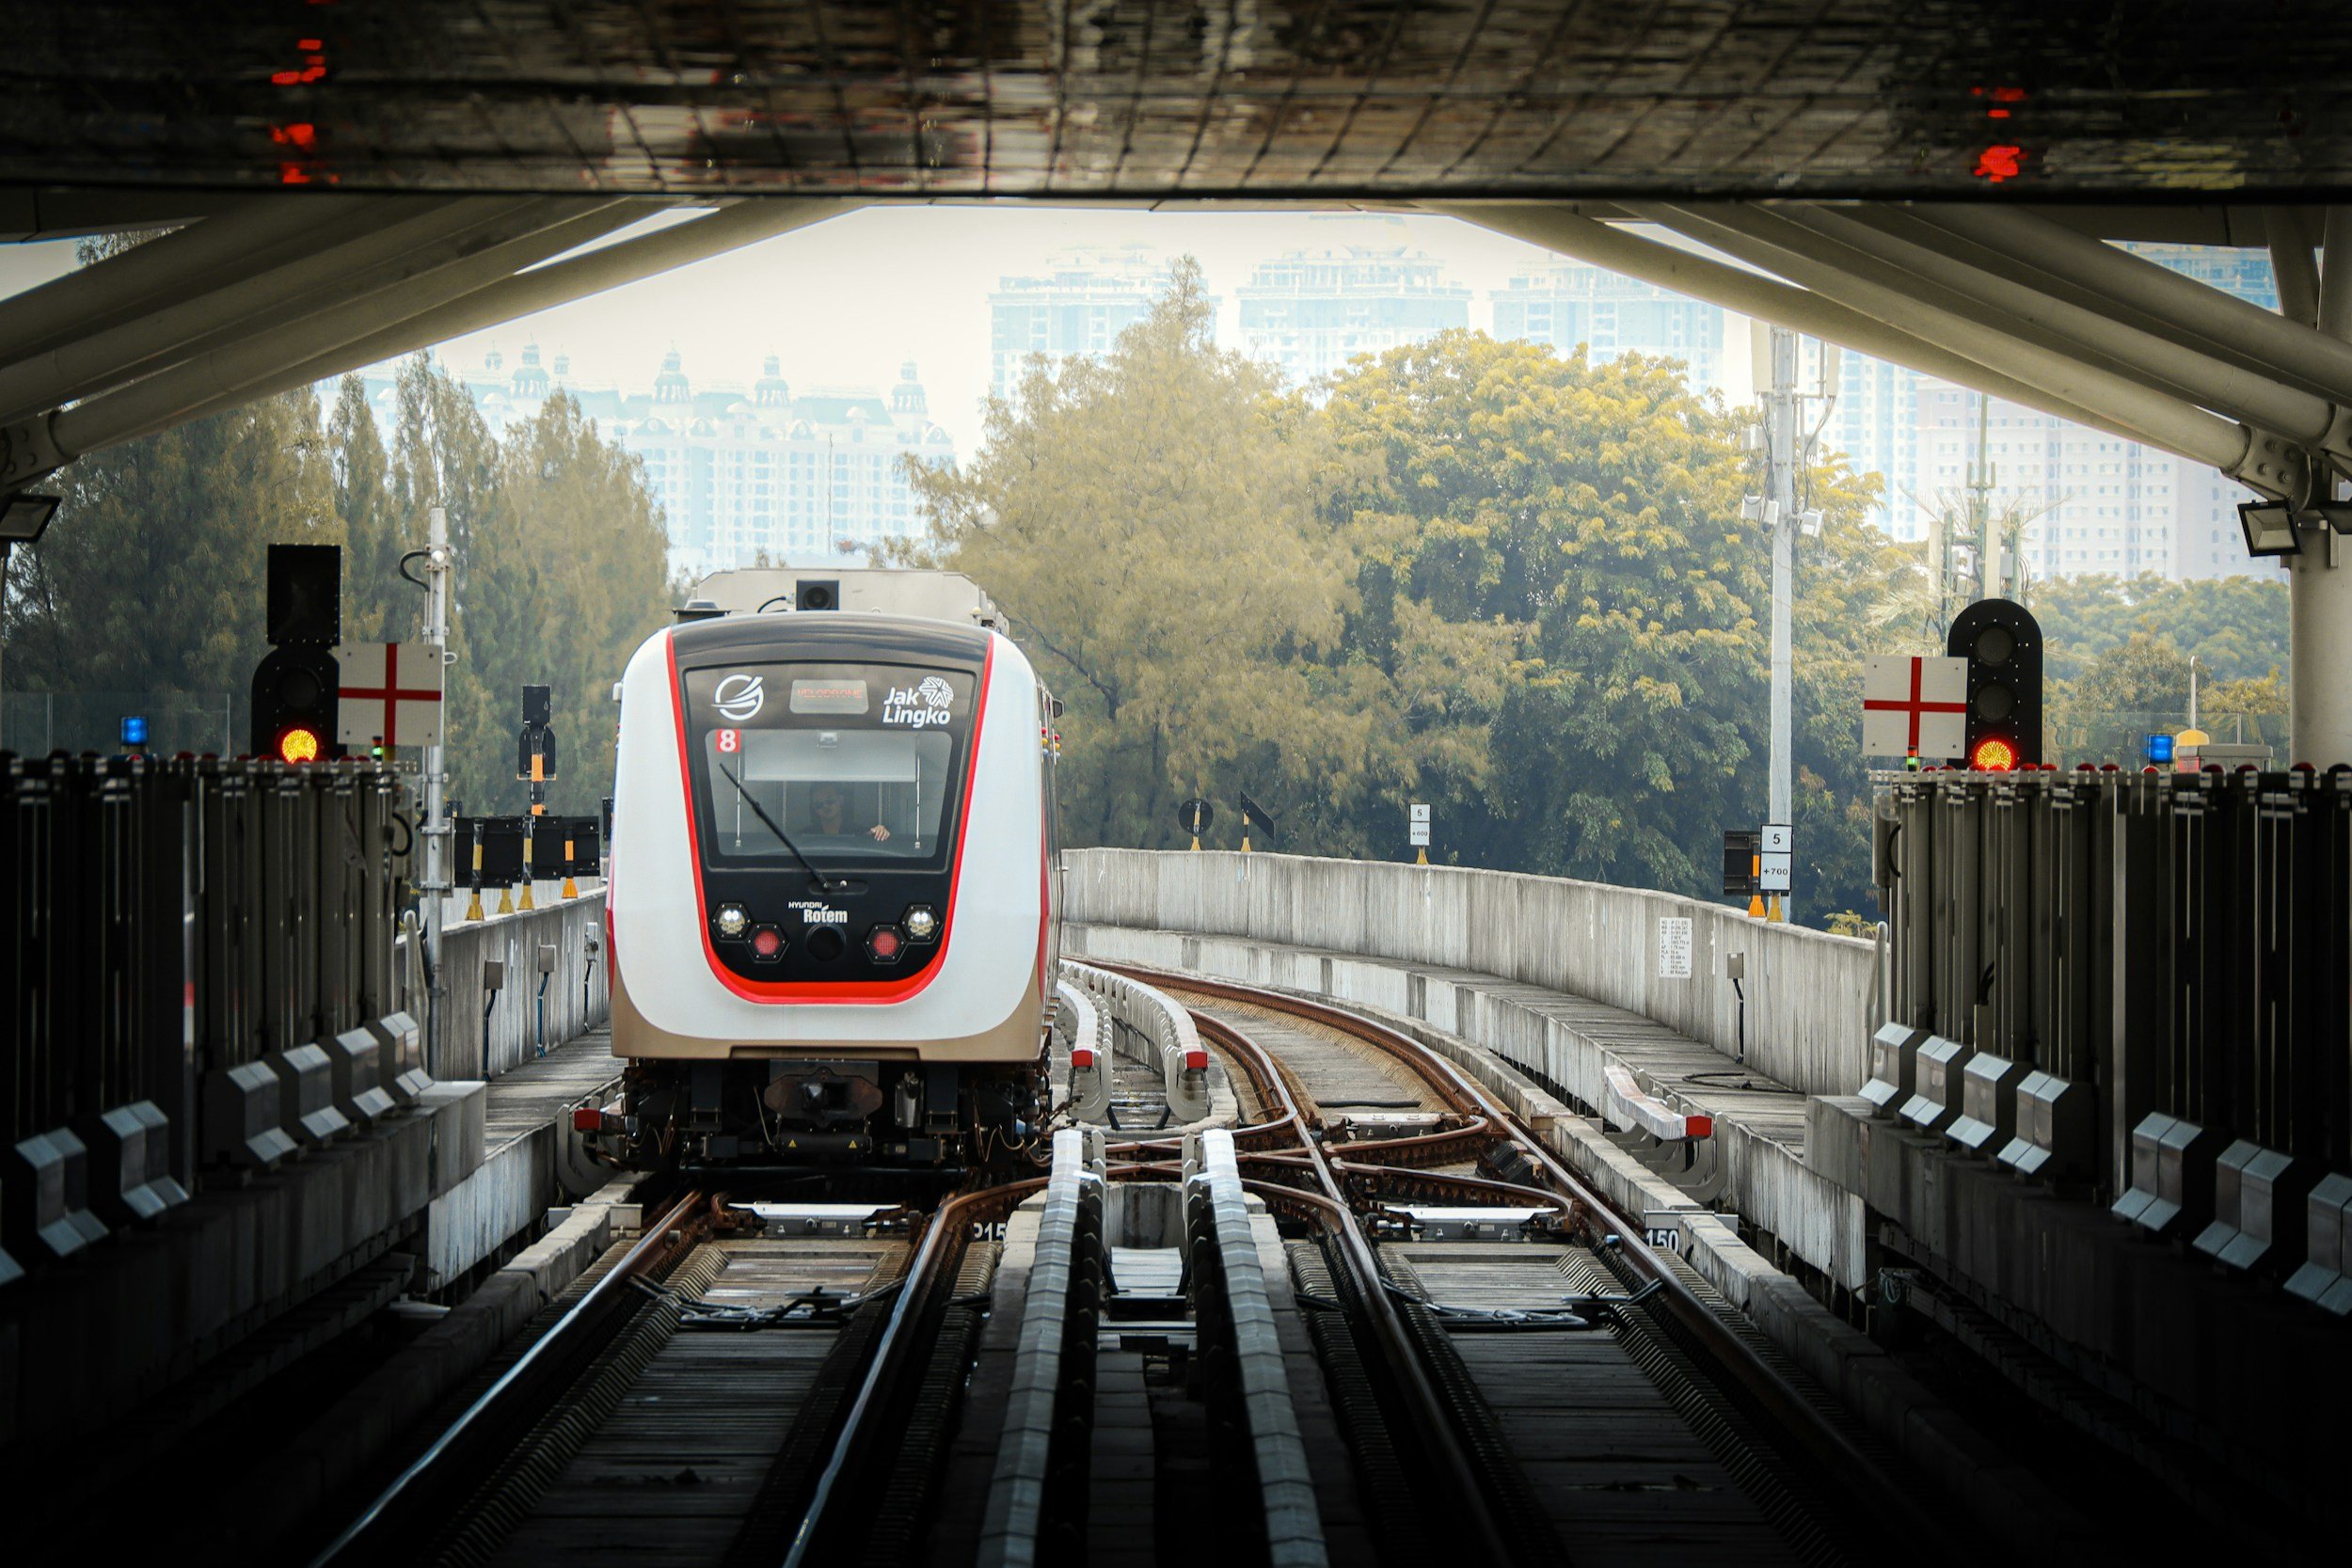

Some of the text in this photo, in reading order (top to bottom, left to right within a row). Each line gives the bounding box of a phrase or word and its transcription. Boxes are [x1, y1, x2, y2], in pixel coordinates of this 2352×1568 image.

[882, 688, 918, 706] Jak
[882, 705, 951, 728] Lingko
[720, 729, 737, 752] 8
[1773, 834, 1780, 844] 5
[803, 906, 848, 924] Rotem
